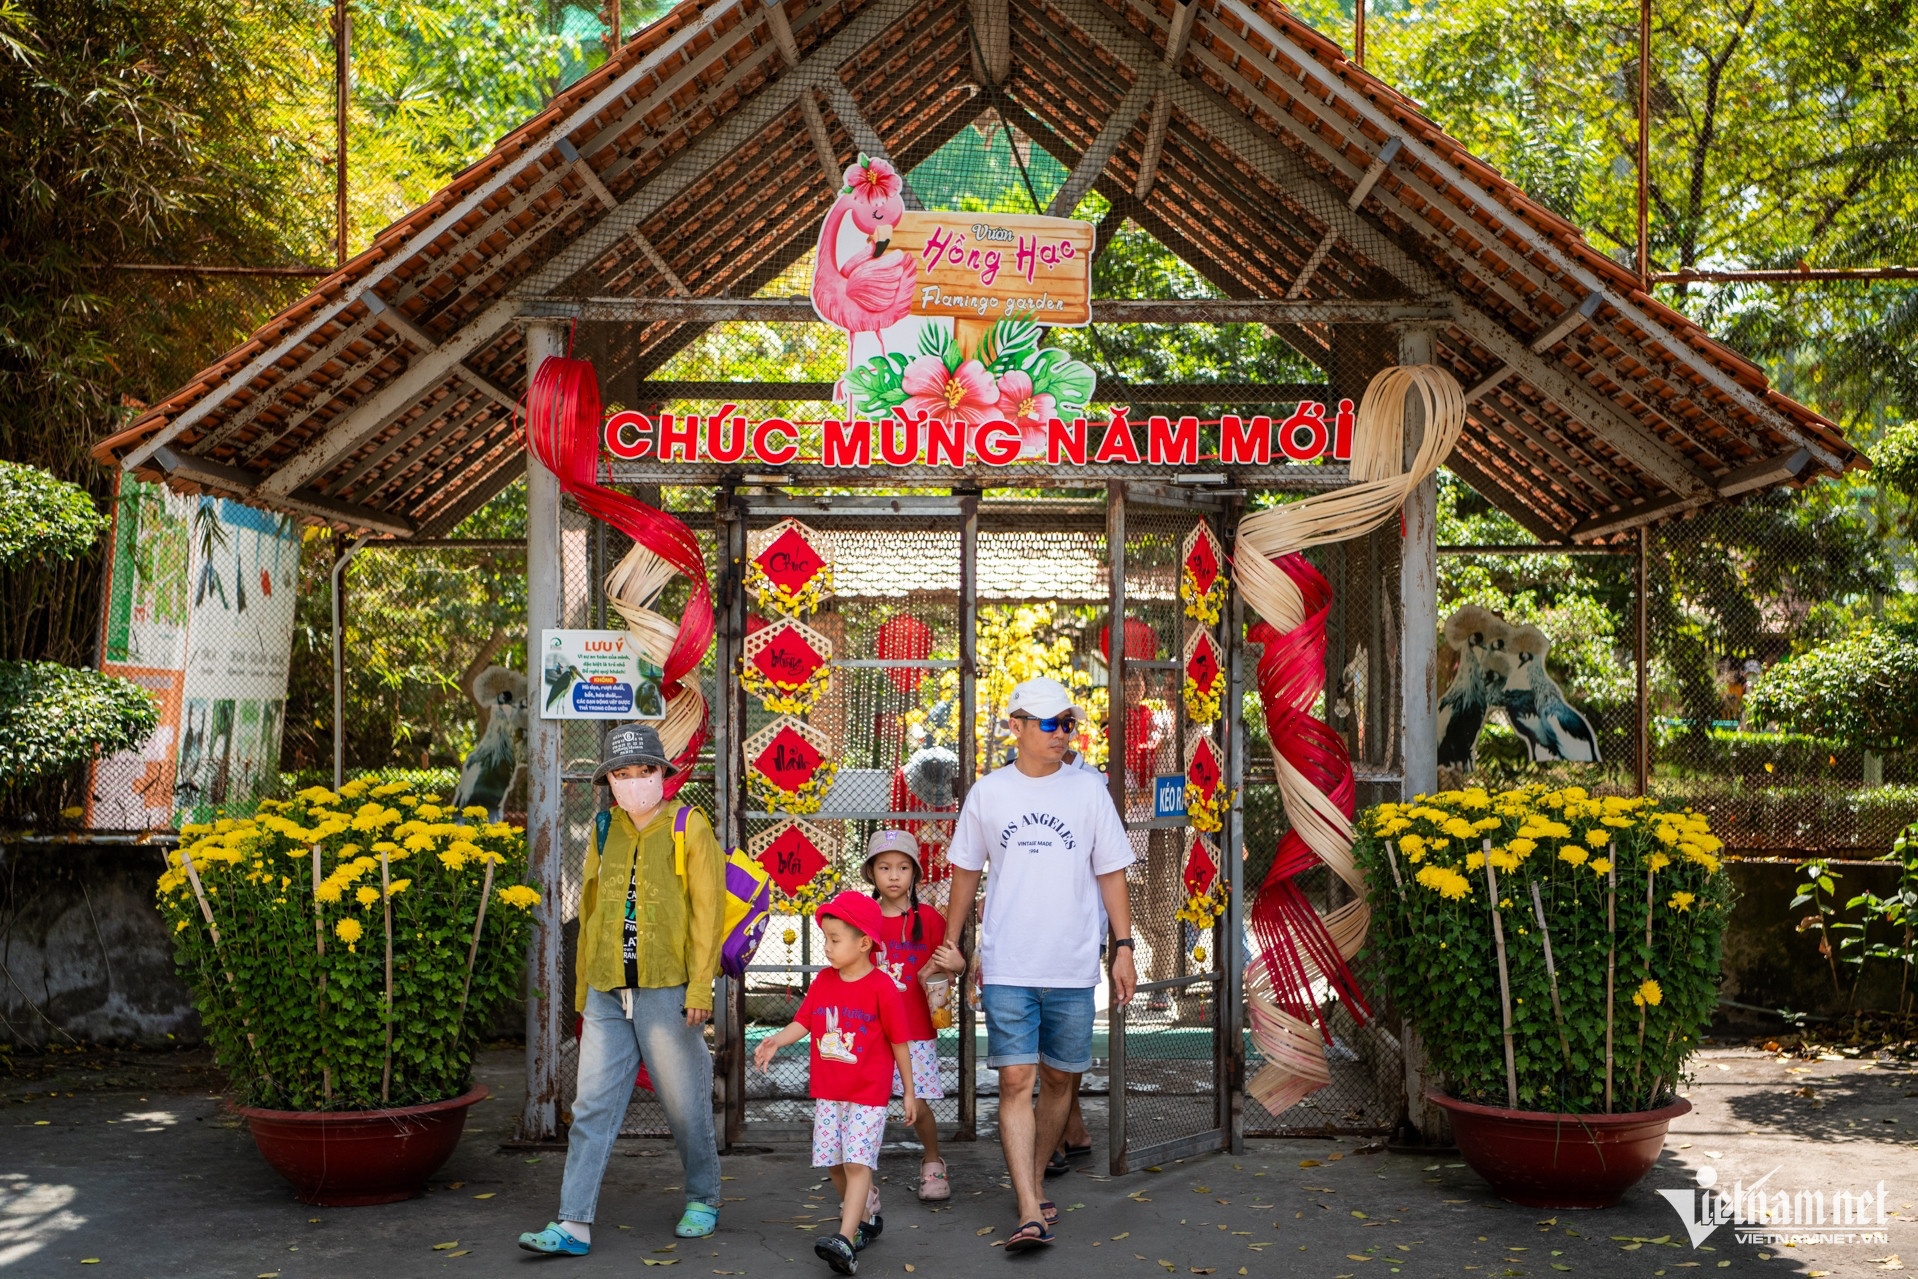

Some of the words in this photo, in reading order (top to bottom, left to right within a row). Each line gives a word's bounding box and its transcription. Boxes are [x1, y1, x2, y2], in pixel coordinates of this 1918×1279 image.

[971, 224, 1014, 243] Vườn
[922, 226, 1000, 286] Hồng
[1017, 234, 1076, 284] Hạc
[921, 286, 999, 316] Flamingo
[1004, 291, 1064, 316] garden
[603, 403, 800, 467] CHÚC
[822, 406, 1023, 468] MỪNG
[1047, 406, 1201, 466] NĂM
[769, 546, 809, 573] Chúc
[585, 640, 613, 652] LƯU
[616, 637, 624, 652] Ý
[1159, 782, 1175, 812] KÉO
[1000, 821, 1018, 849] LOS
[1021, 812, 1077, 850] ANGELES
